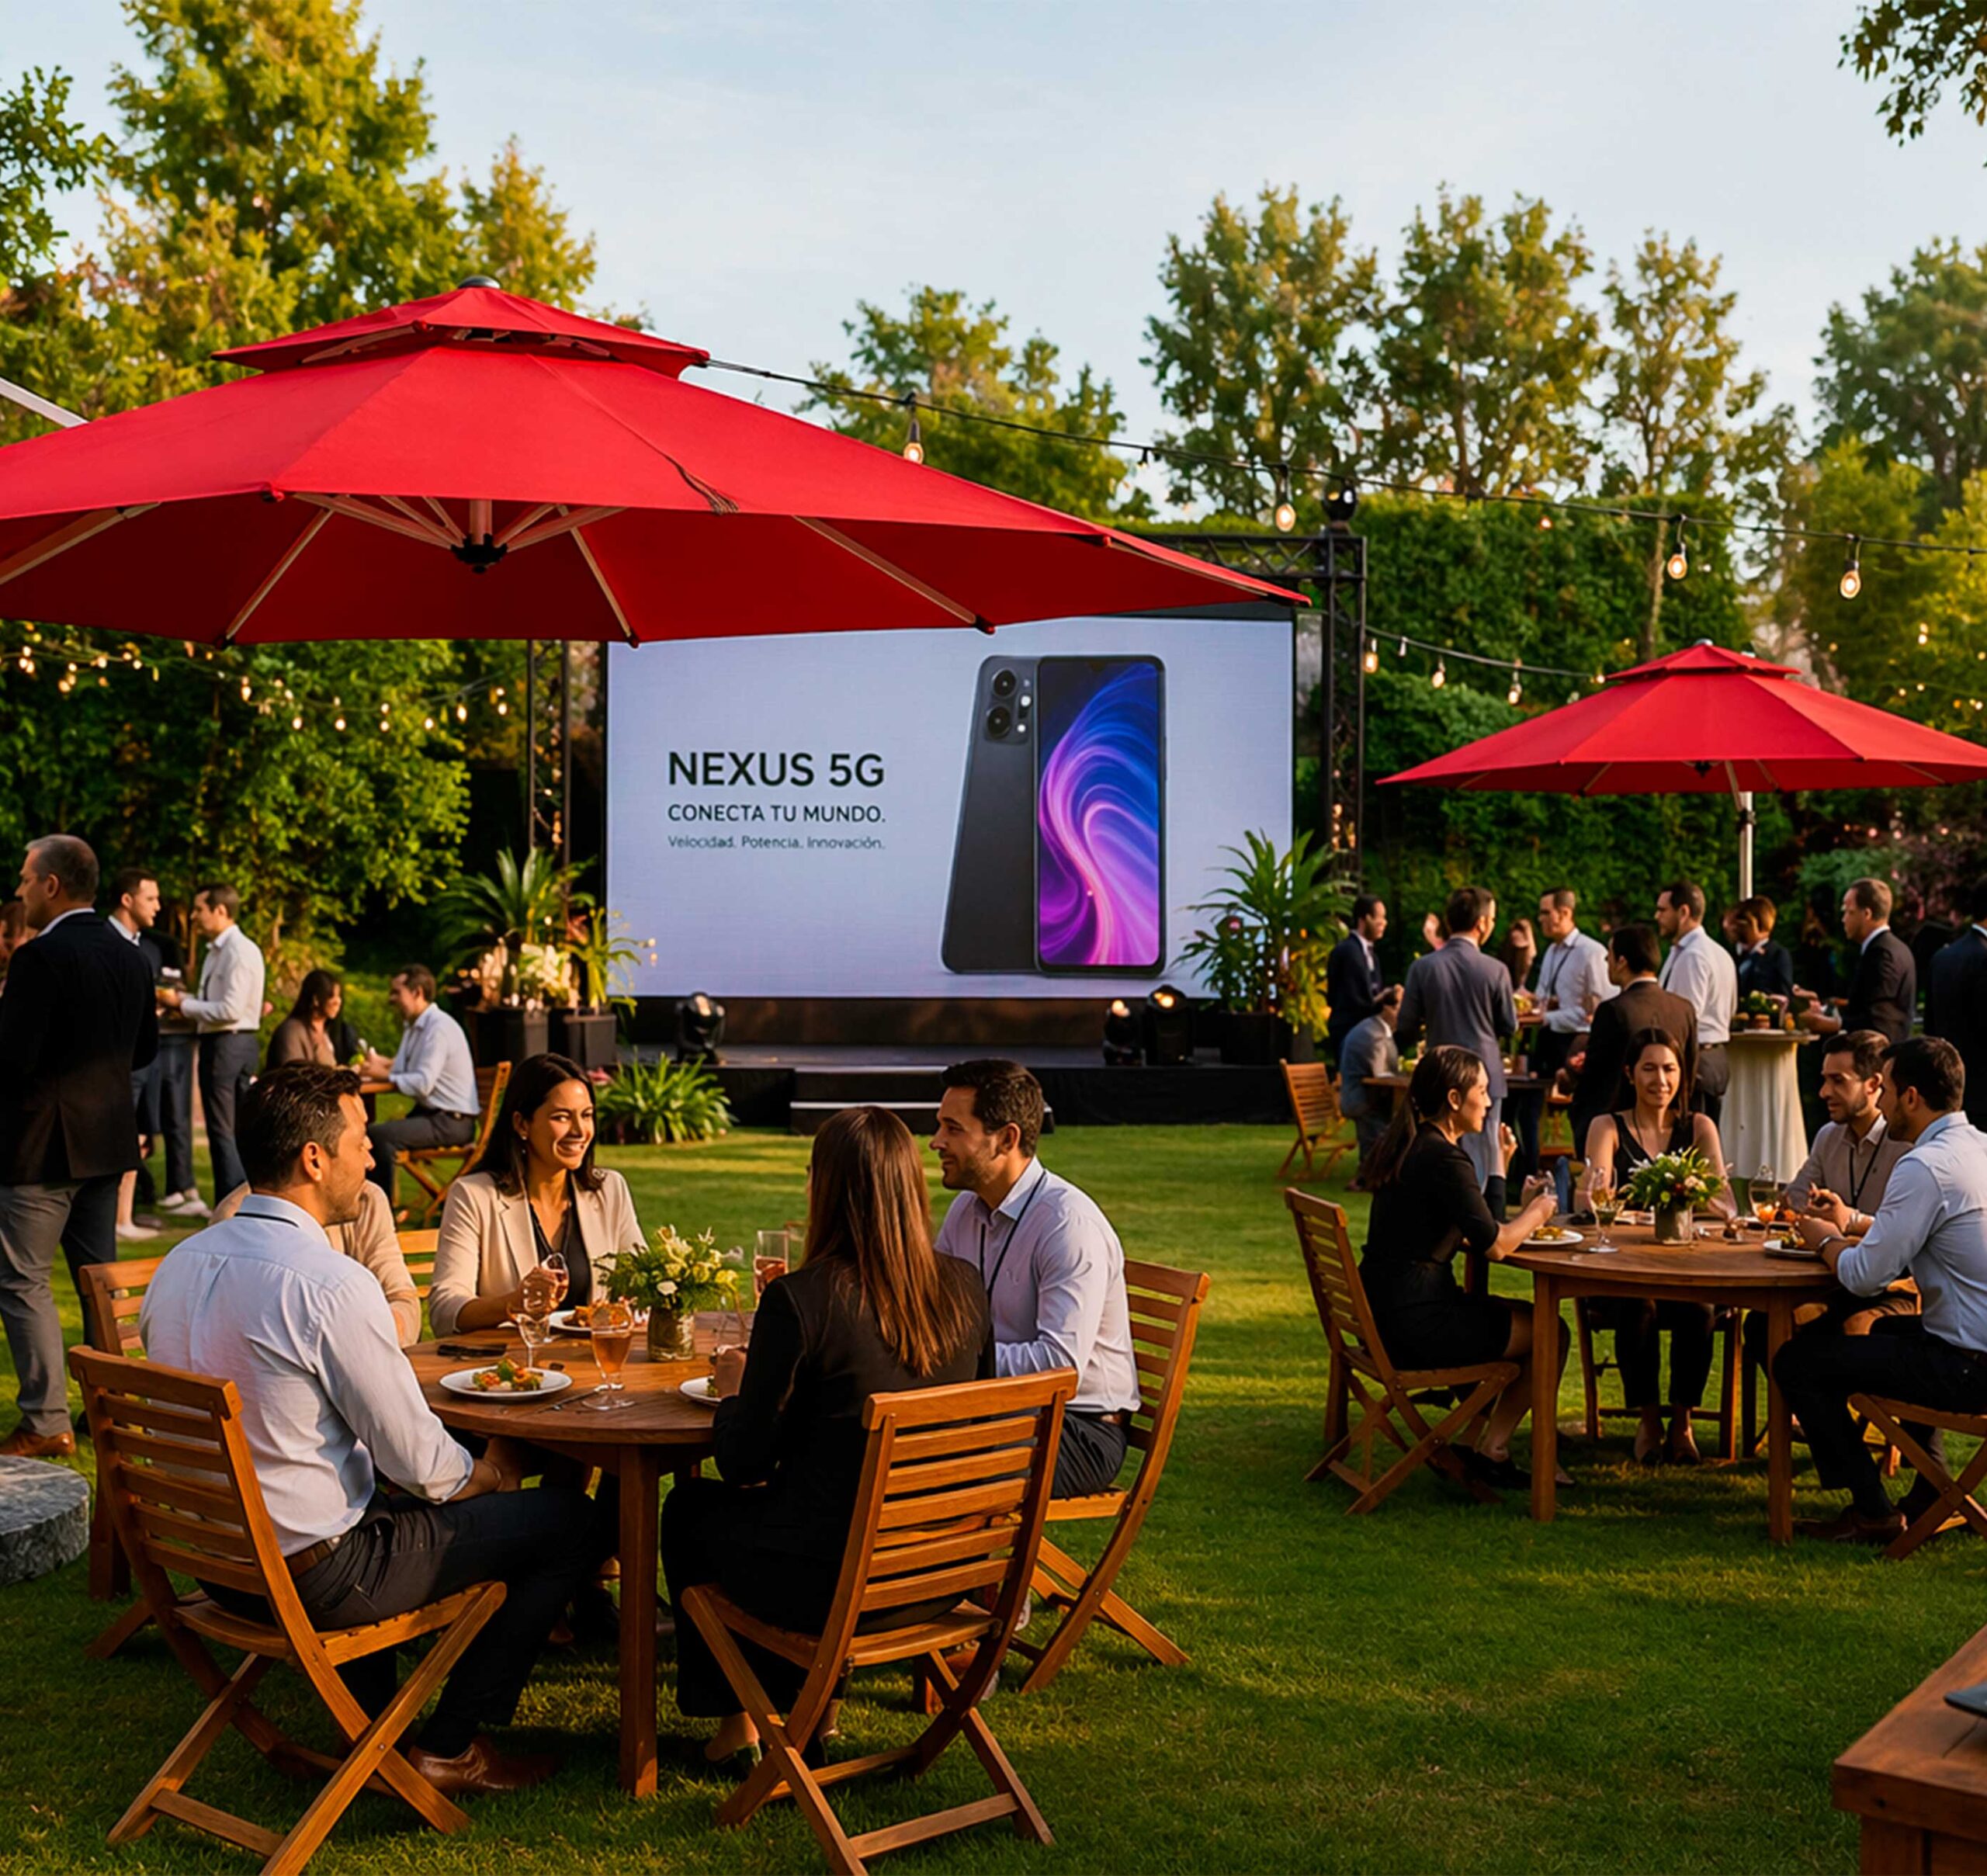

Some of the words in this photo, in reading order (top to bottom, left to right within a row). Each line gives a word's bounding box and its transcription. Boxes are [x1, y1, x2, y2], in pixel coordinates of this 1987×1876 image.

[669, 752, 814, 786] NEXUS
[830, 753, 884, 787] 5G
[668, 804, 765, 821] CONECTA
[770, 805, 796, 822] TU
[803, 805, 886, 823] MUNDO.
